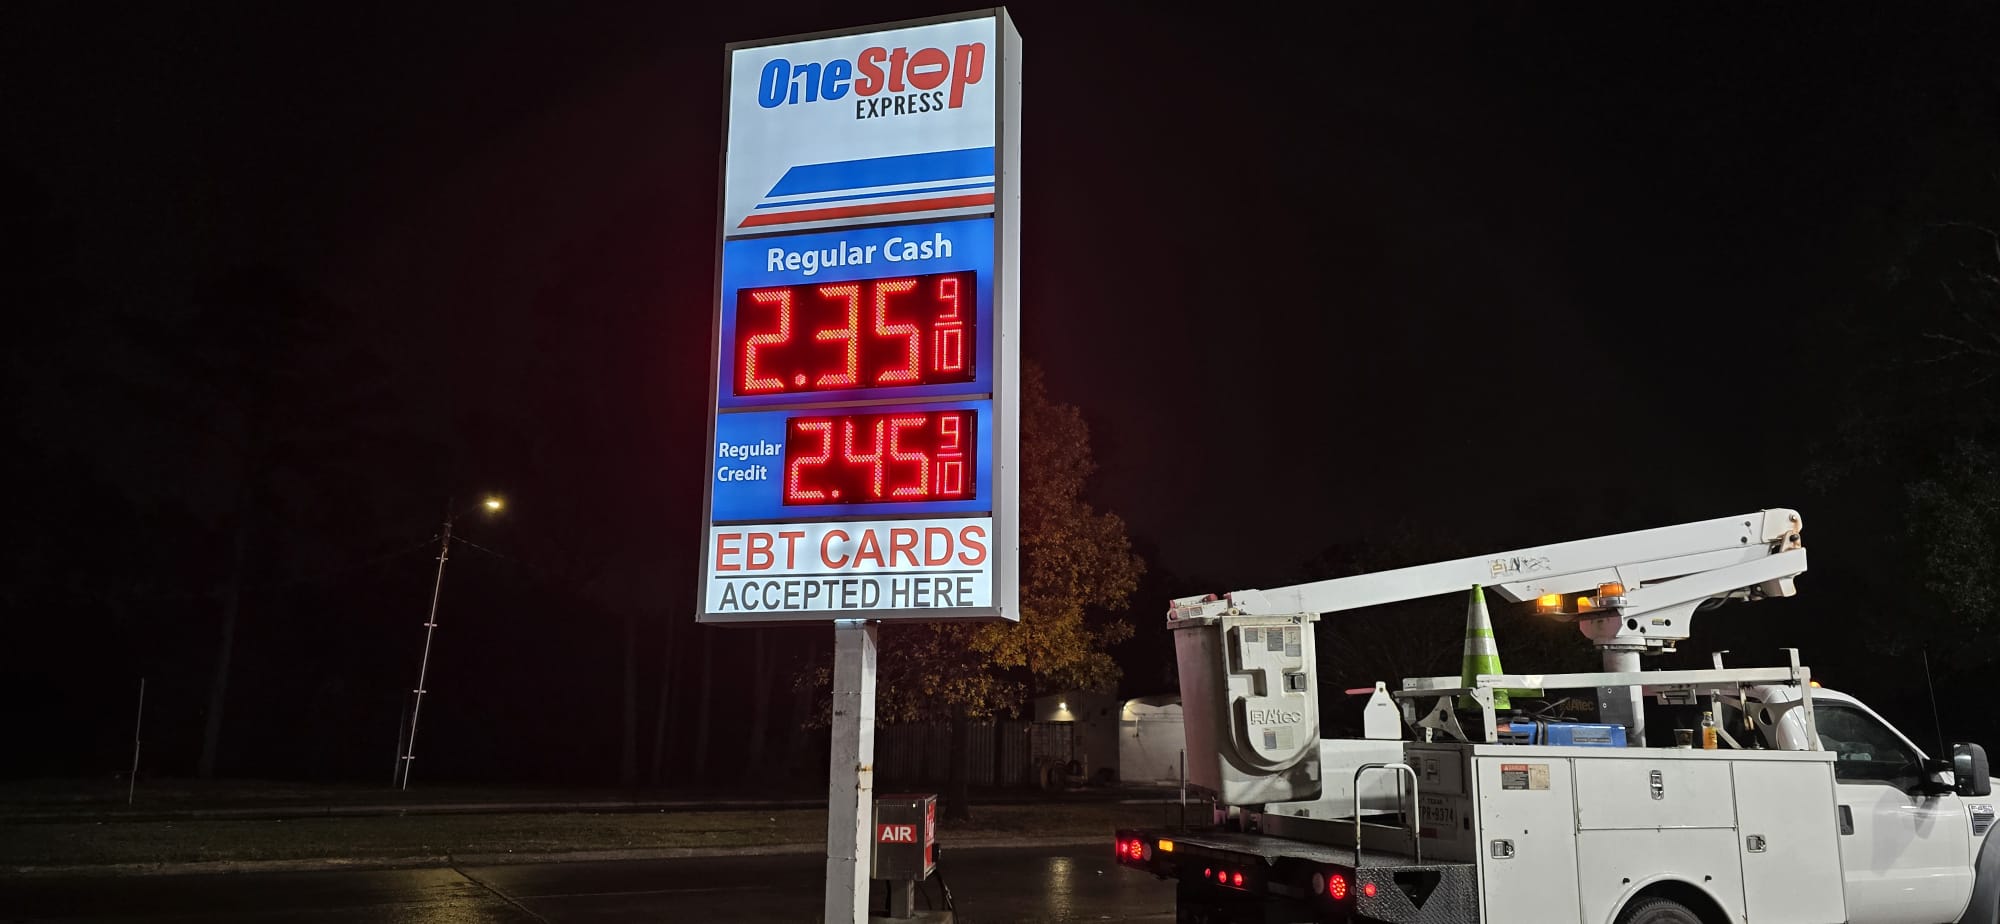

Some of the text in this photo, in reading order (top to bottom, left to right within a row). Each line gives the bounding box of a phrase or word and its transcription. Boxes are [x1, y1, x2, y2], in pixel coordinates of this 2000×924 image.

[856, 91, 944, 120] EXPRESS
[767, 233, 952, 276] Regular Cash
[744, 280, 919, 390] 2.35
[718, 440, 782, 461] Regular
[790, 417, 929, 499] 2.45
[717, 465, 767, 483] Credit
[715, 525, 987, 572] EBT CARDS
[719, 577, 974, 611] ACCEPTED HERE
[881, 826, 912, 841] AIR
